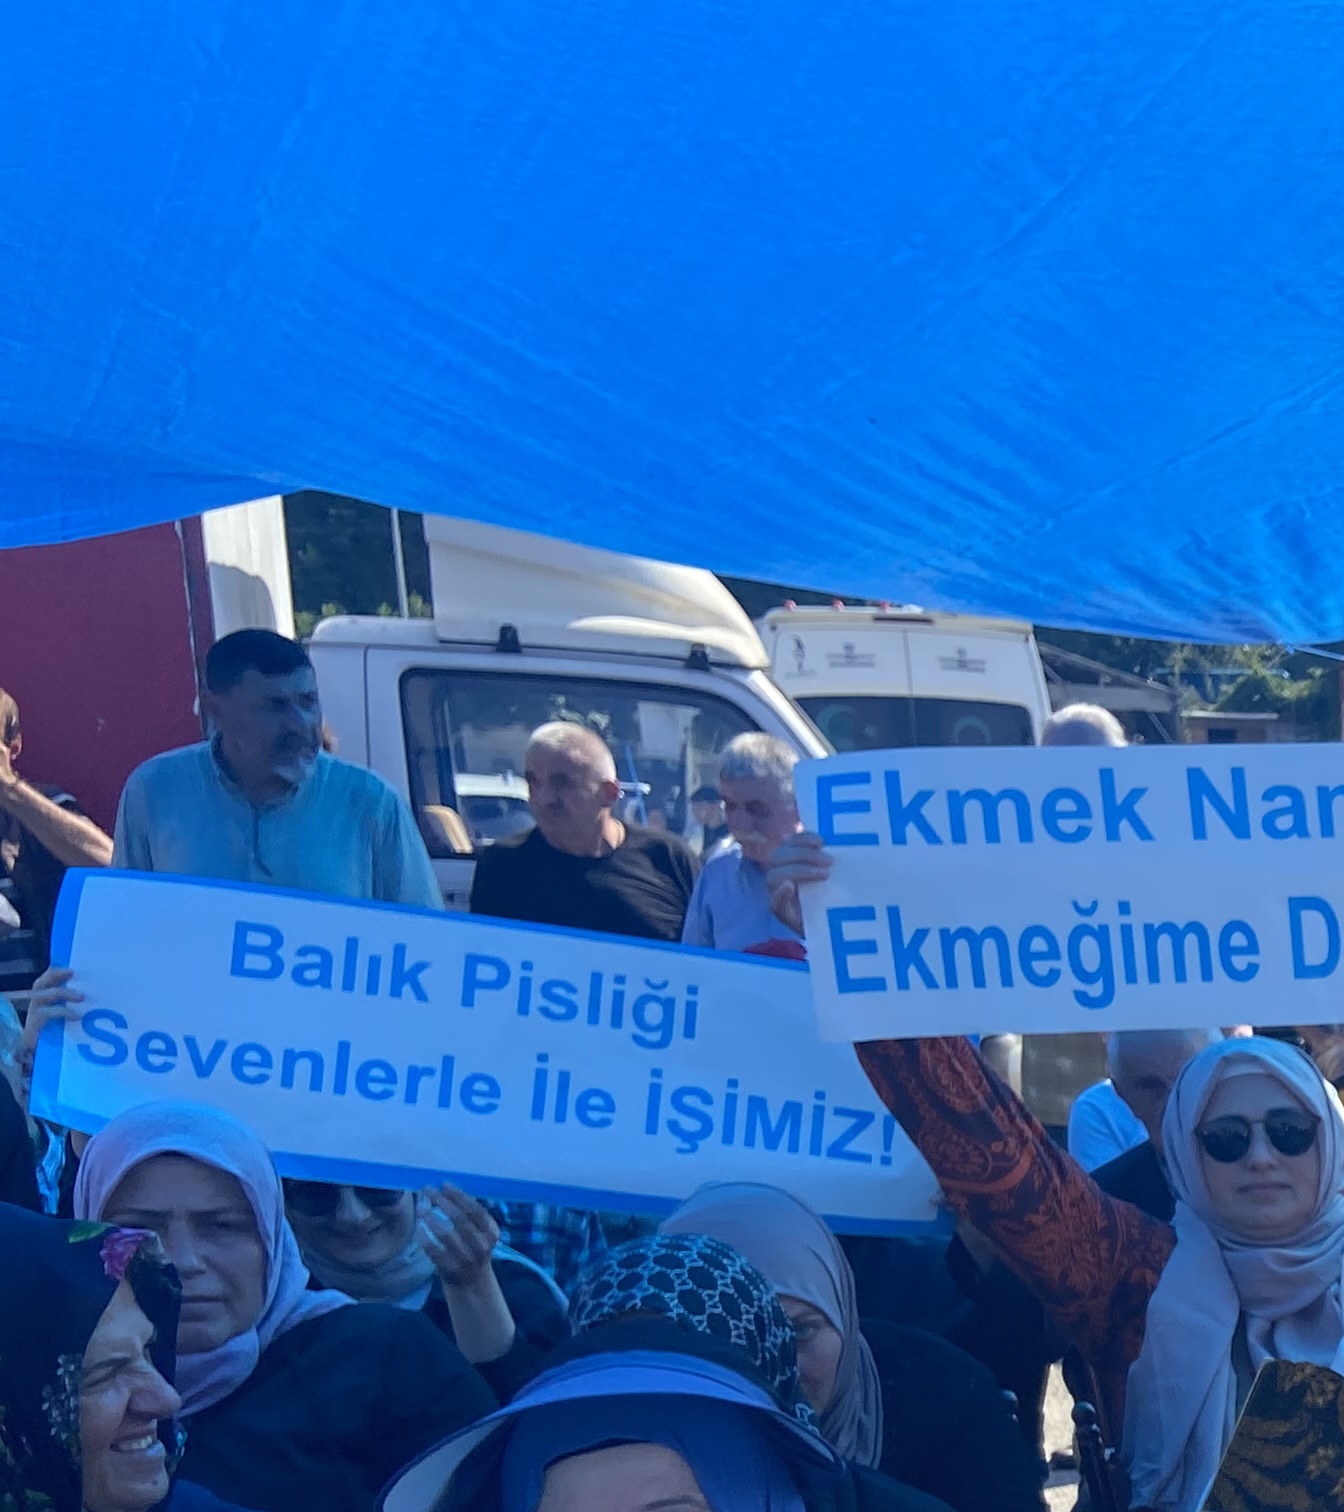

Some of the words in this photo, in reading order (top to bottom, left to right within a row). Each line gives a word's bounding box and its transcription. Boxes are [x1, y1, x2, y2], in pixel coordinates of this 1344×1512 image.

[816, 768, 1154, 846] Ekmek
[230, 921, 430, 1002] Balık
[461, 953, 698, 1049] Pisliği
[827, 901, 1259, 1009] Ekmeğime
[78, 1009, 502, 1116] Sevenlerle
[531, 1053, 617, 1128] İle
[645, 1068, 897, 1166] İŞİMİZ!
